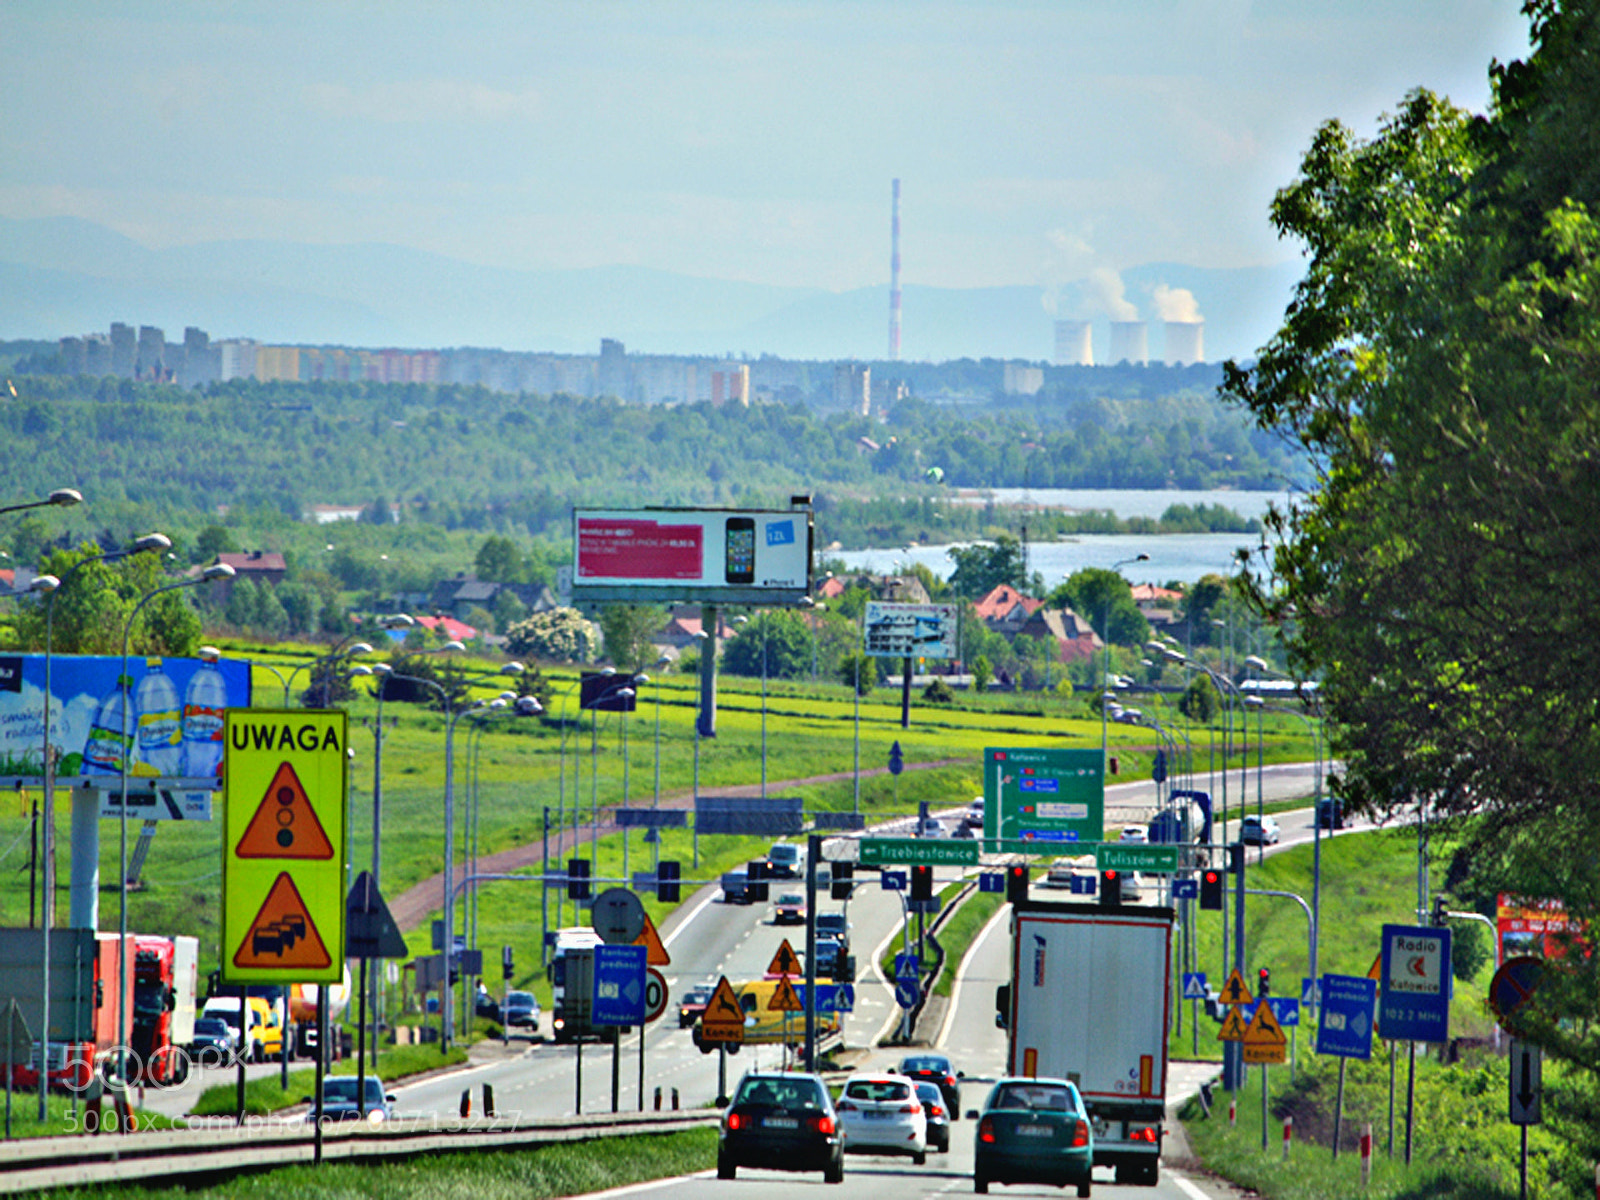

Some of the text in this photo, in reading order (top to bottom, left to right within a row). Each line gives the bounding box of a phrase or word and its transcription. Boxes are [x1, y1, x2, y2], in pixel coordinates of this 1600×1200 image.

[232, 724, 340, 752] UWAGA
[1397, 937, 1437, 952] Radio
[1389, 979, 1439, 992] Katowice
